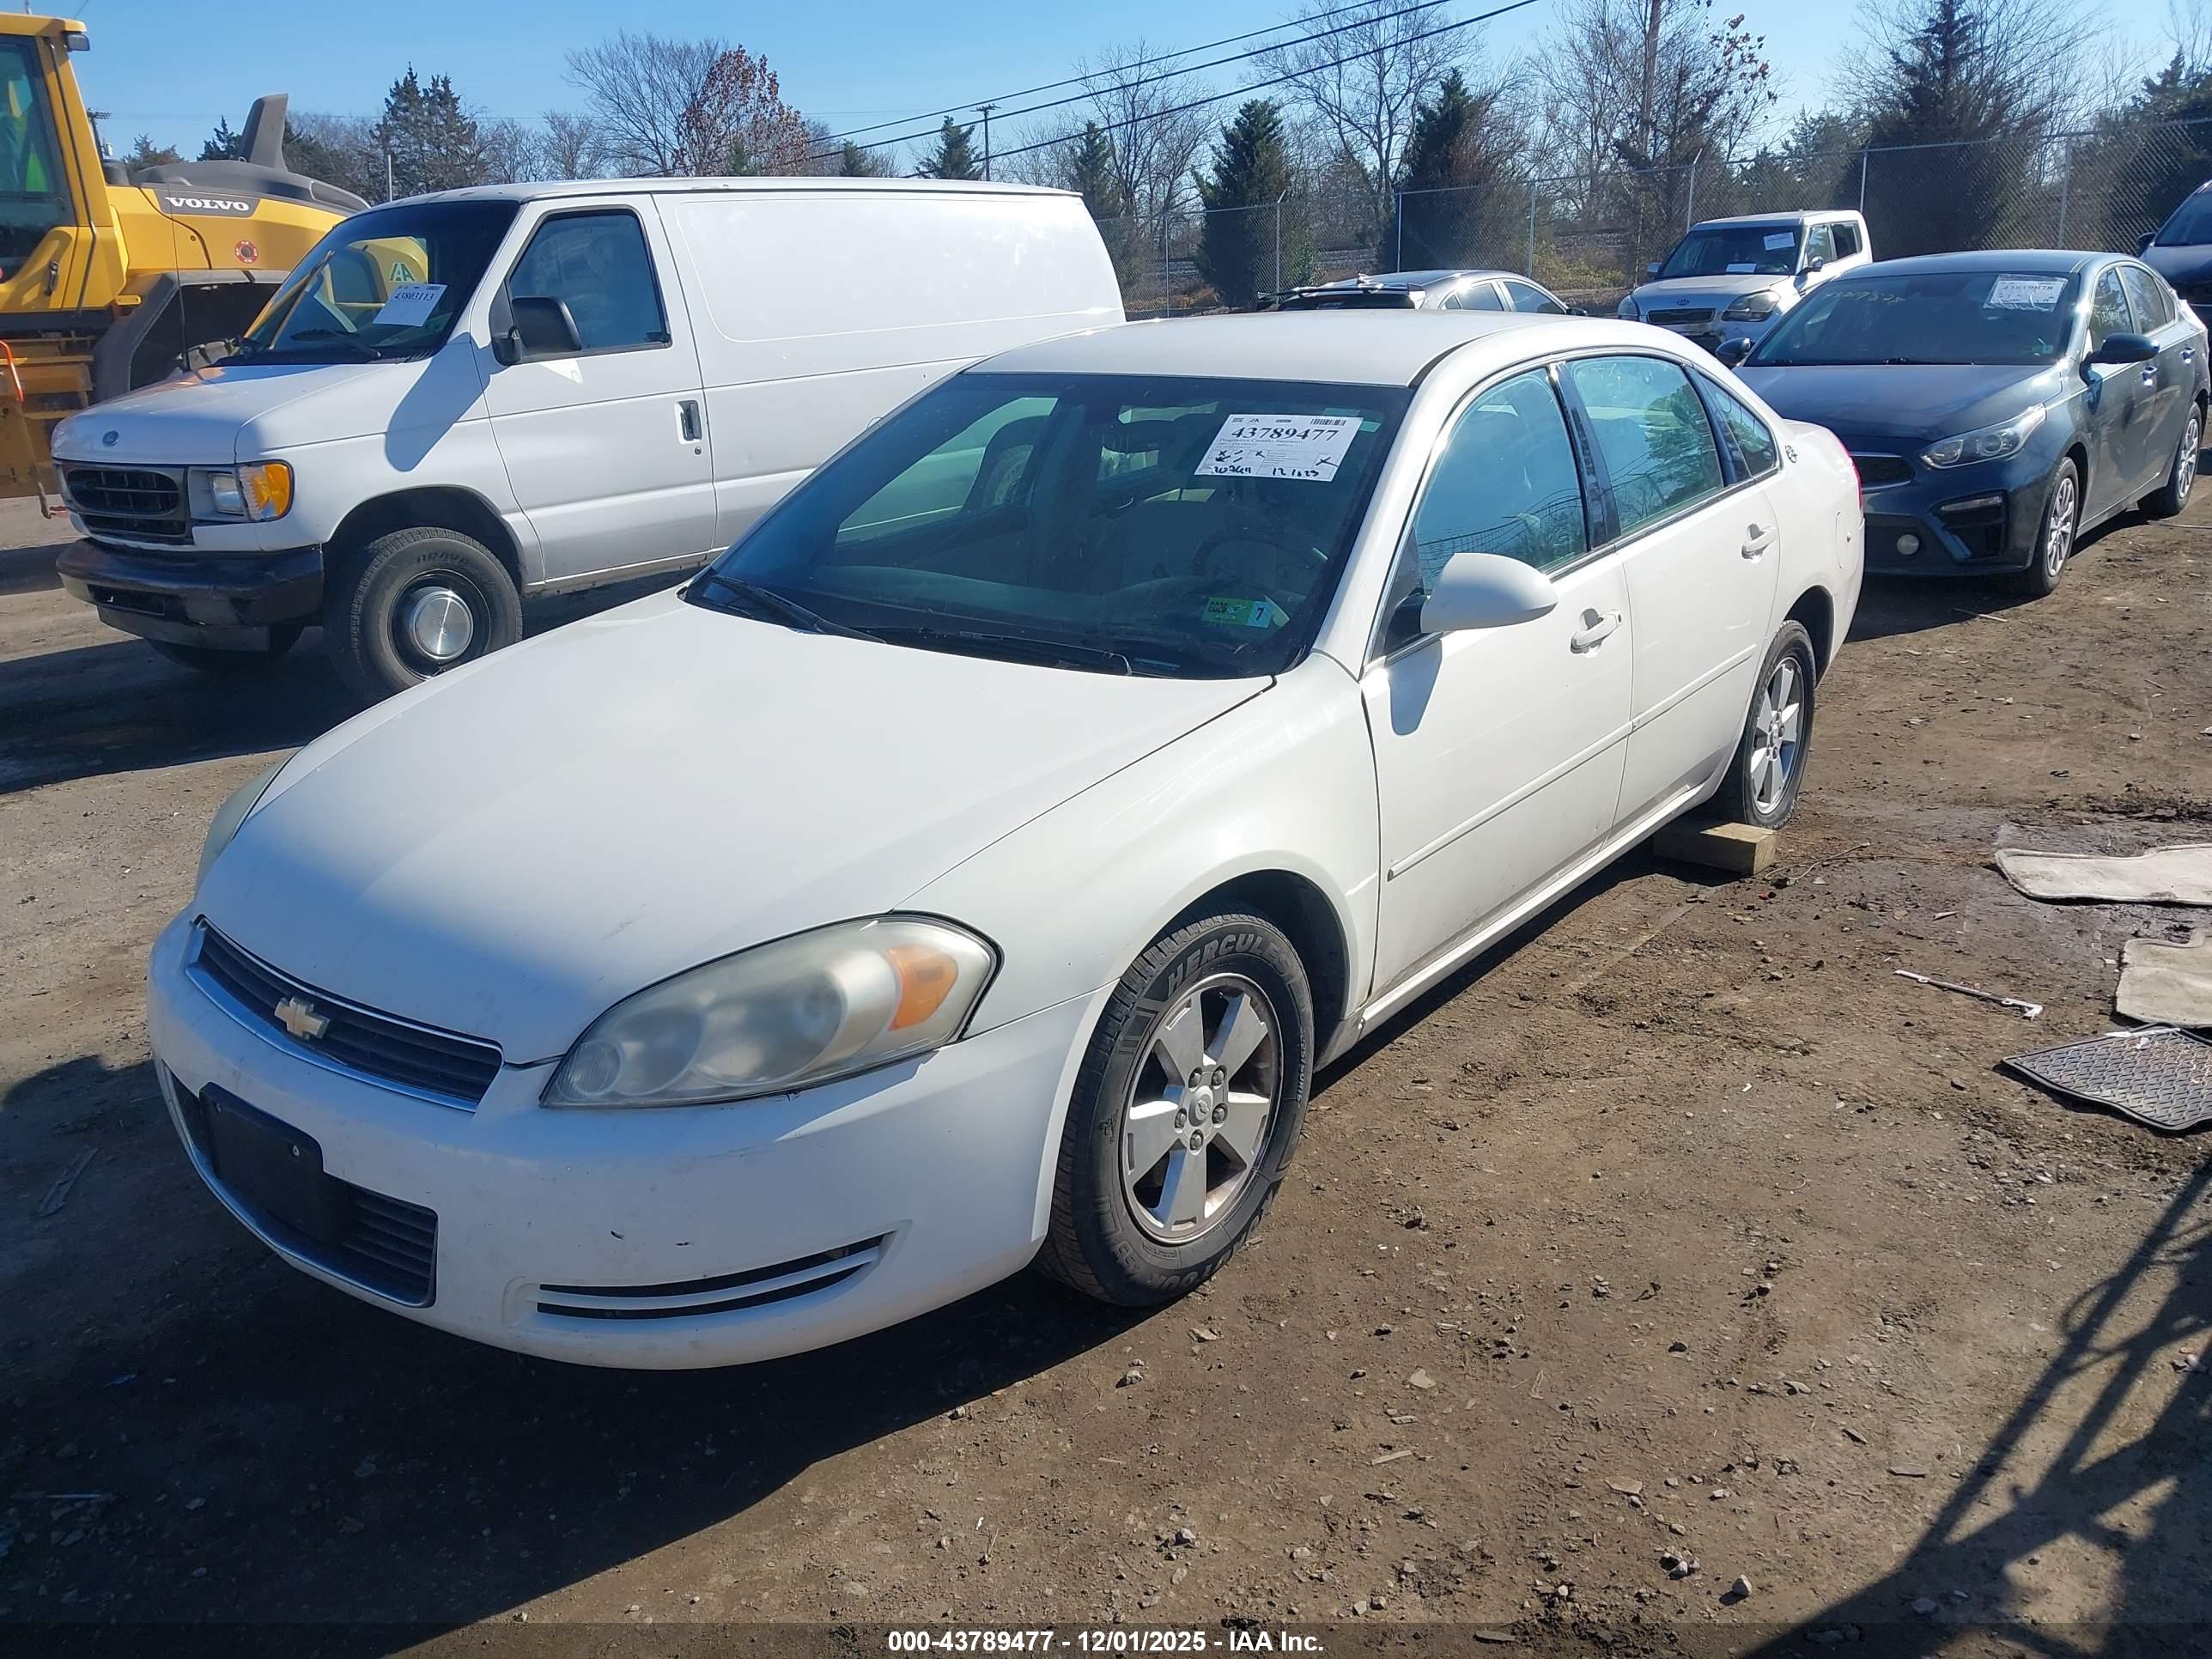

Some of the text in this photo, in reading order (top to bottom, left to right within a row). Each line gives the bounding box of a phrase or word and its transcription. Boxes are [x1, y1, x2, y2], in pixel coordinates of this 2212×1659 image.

[165, 198, 249, 211] VOLVO
[1231, 427, 1340, 441] 43789477
[1255, 607, 1265, 620] 7
[1168, 933, 1293, 997] HERCULES
